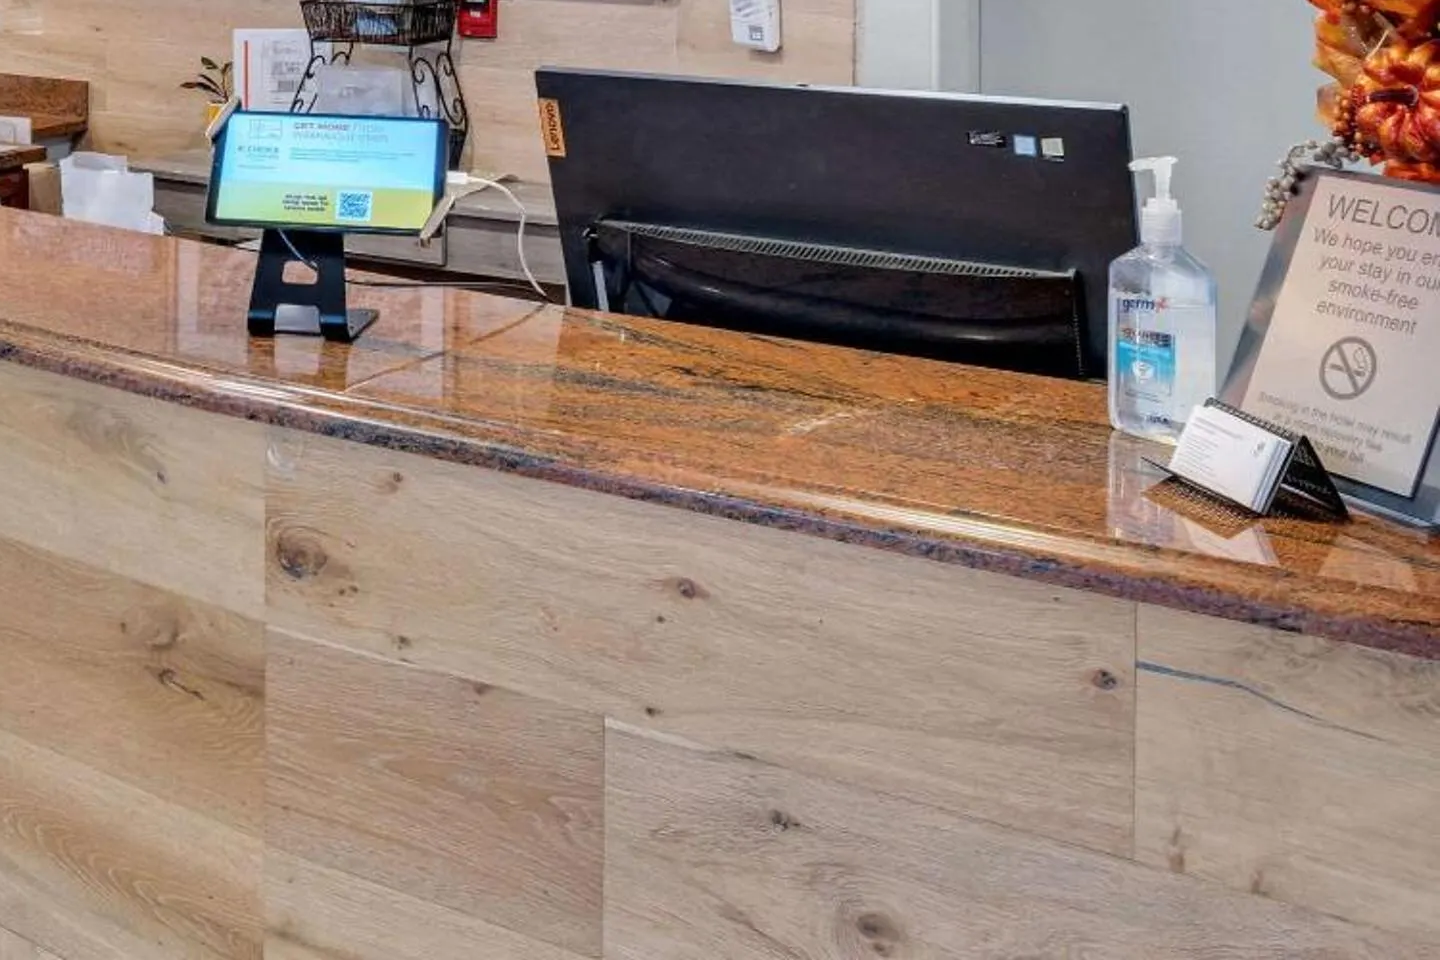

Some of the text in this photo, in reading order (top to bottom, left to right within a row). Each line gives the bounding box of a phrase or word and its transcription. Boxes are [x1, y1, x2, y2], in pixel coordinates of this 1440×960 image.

[545, 102, 561, 150] Lenovo
[1314, 227, 1339, 246] We
[1341, 233, 1383, 256] hope
[1385, 244, 1418, 261] you
[1319, 256, 1354, 272] your
[1357, 261, 1392, 284] stay
[1397, 267, 1411, 285] in
[1328, 279, 1419, 310] smoke-free
[1316, 300, 1417, 334] environment
